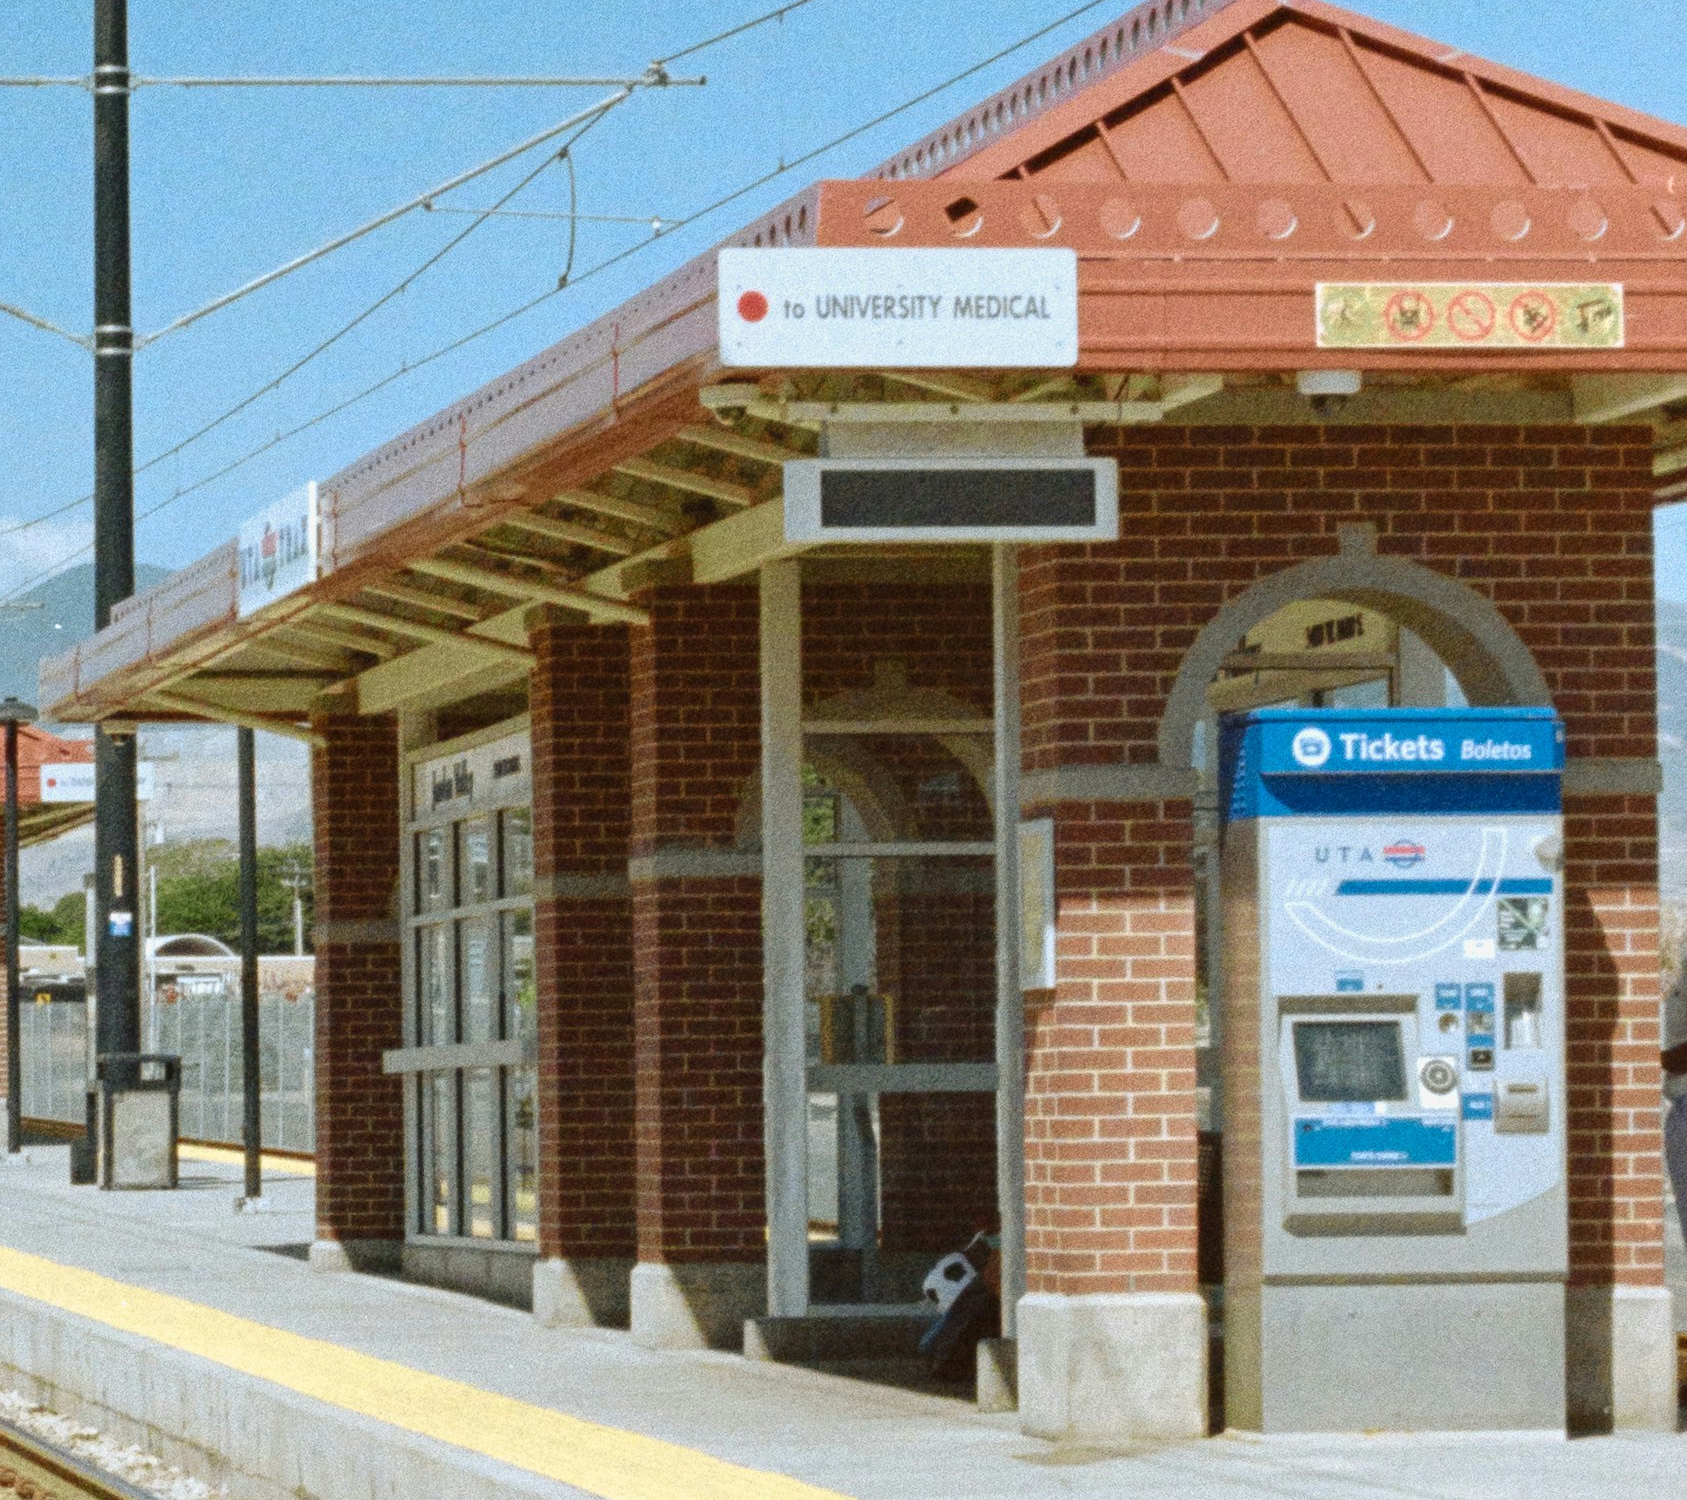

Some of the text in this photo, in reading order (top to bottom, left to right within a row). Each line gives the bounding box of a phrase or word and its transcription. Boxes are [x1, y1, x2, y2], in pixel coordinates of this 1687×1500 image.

[784, 295, 1051, 320] to UNIVERSITY MEDICAL
[1339, 731, 1532, 761] Tickets Boletos
[1314, 846, 1374, 863] UTA
